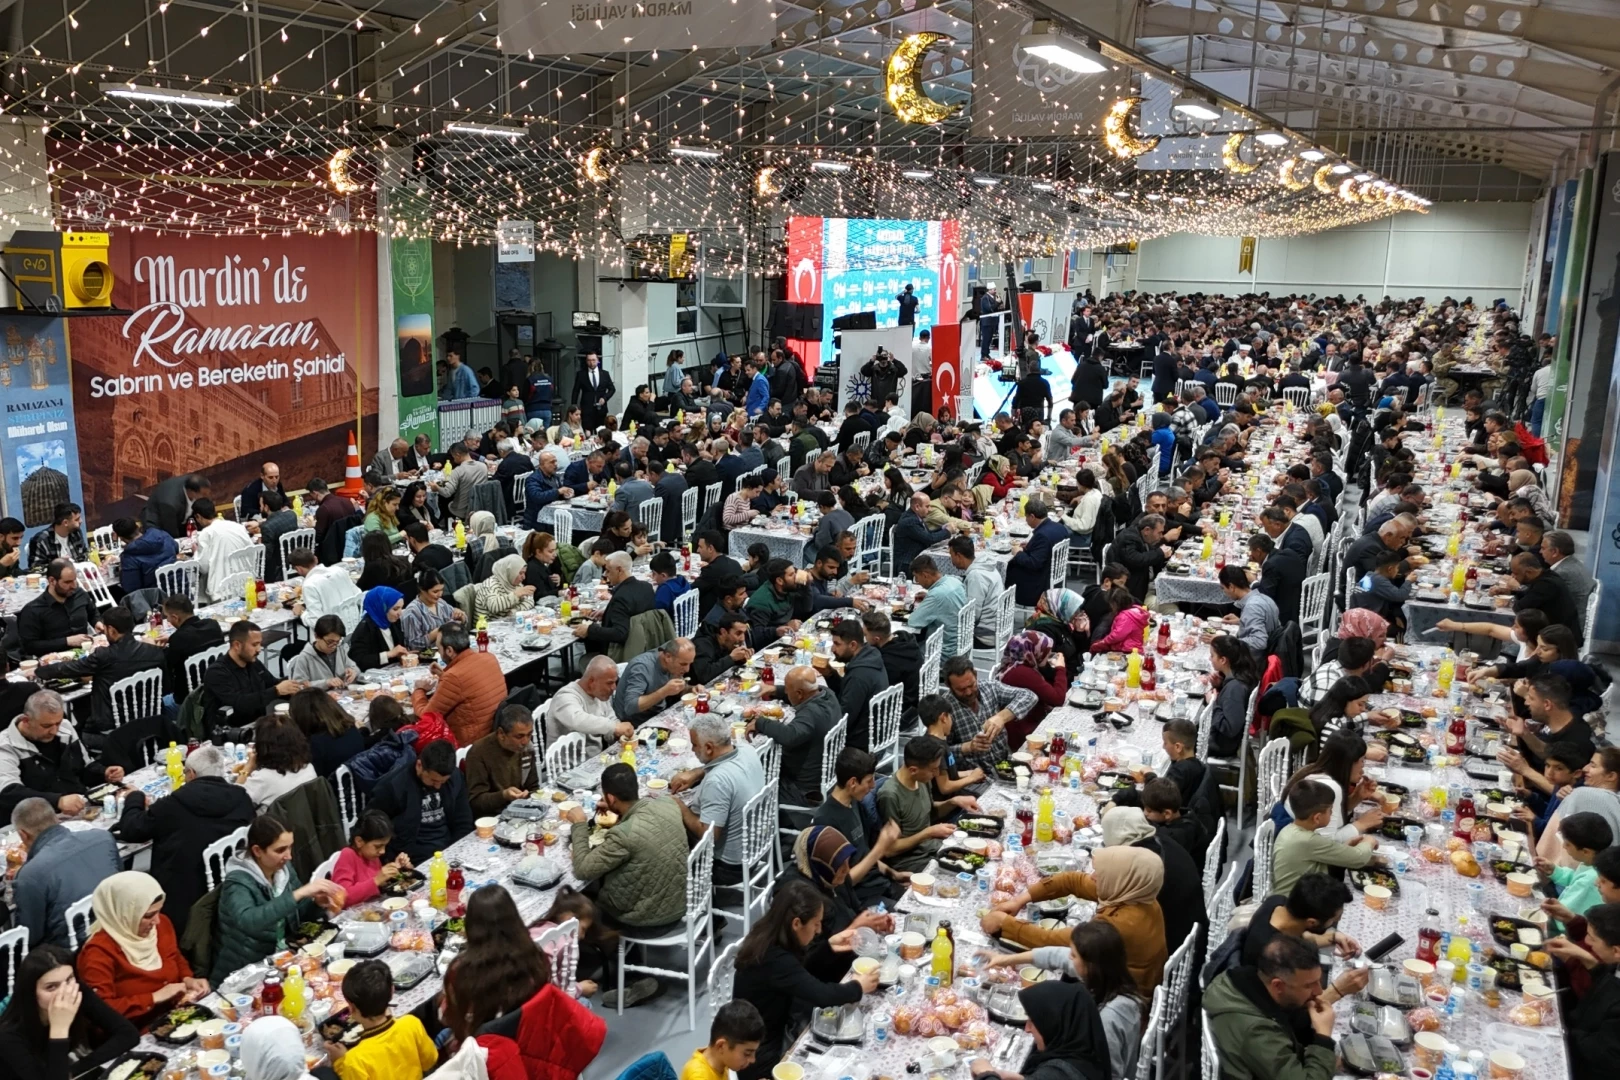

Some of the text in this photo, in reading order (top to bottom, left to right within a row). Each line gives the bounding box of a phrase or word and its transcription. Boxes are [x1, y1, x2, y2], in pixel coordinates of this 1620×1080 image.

[122, 301, 320, 367] Ramazan,
[90, 352, 346, 398] Sabrın ve Bereketin Şahidi
[46, 420, 68, 433] Olsun
